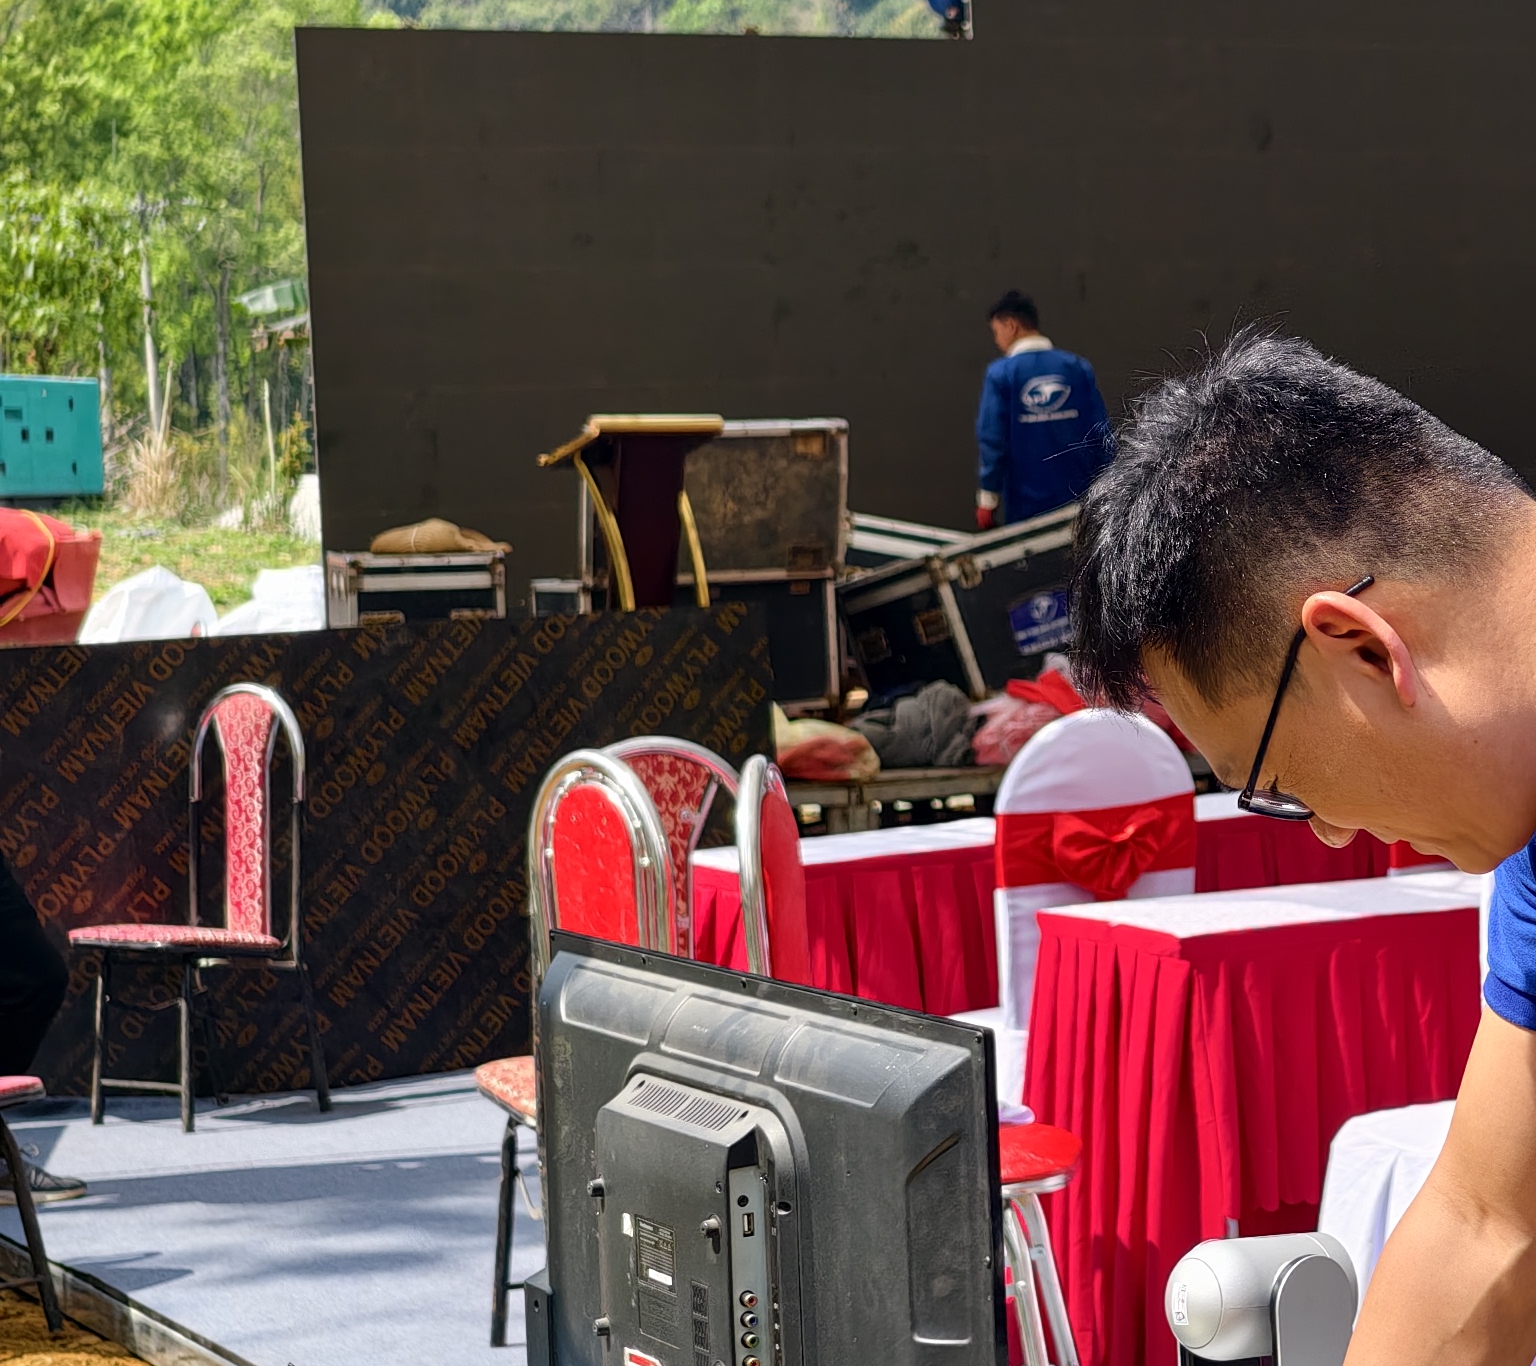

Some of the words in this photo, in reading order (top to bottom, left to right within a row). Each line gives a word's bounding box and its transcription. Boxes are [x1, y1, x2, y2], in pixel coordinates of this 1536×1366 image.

[56, 680, 154, 783] VIETNAM
[452, 653, 538, 748] VIETNAM
[503, 698, 588, 794] VIETNAM
[309, 708, 405, 818] PLYWOOD
[361, 752, 456, 863] PLYWOOD
[36, 833, 116, 919] PLYWO
[411, 797, 506, 907] PLYWOOD
[296, 865, 366, 941] VIETN
[330, 908, 417, 1007] VIETNAM
[381, 952, 468, 1050] VIETNAM
[446, 995, 519, 1069] VIETNA
